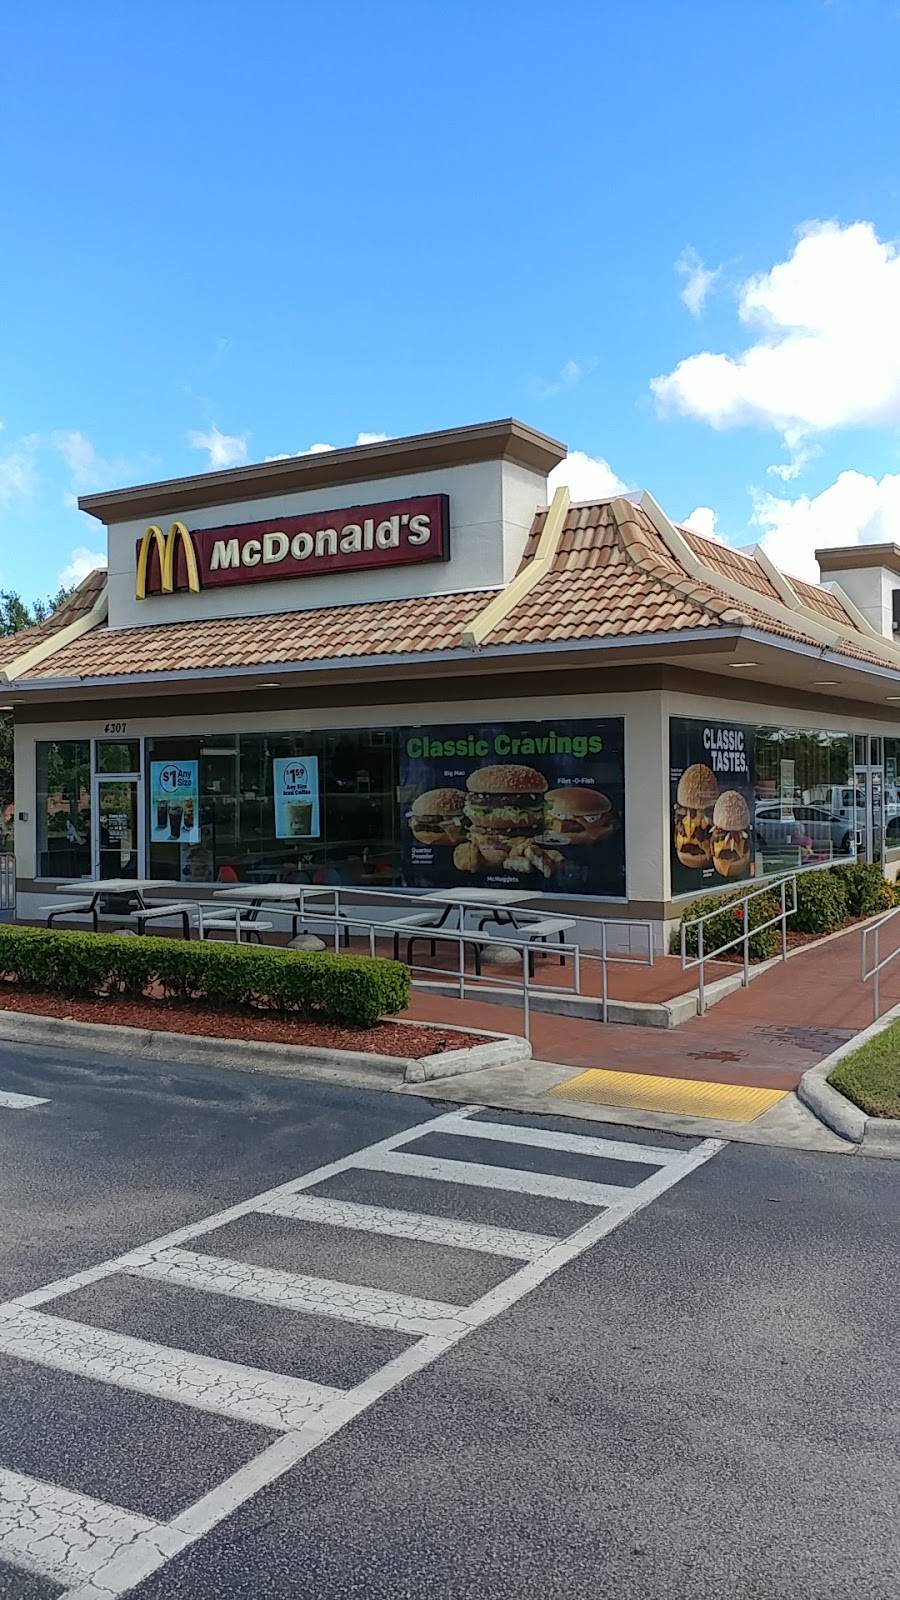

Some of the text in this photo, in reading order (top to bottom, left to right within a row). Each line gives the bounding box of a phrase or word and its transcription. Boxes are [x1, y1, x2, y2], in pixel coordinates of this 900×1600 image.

[209, 514, 431, 571] McDonald's
[104, 722, 127, 734] 4307
[406, 731, 603, 758] Classic Cravings
[703, 728, 744, 751] CLASSIC
[711, 750, 748, 772] TASTES.
[163, 770, 177, 787] $1
[177, 769, 192, 779] Any
[177, 779, 192, 787] Size
